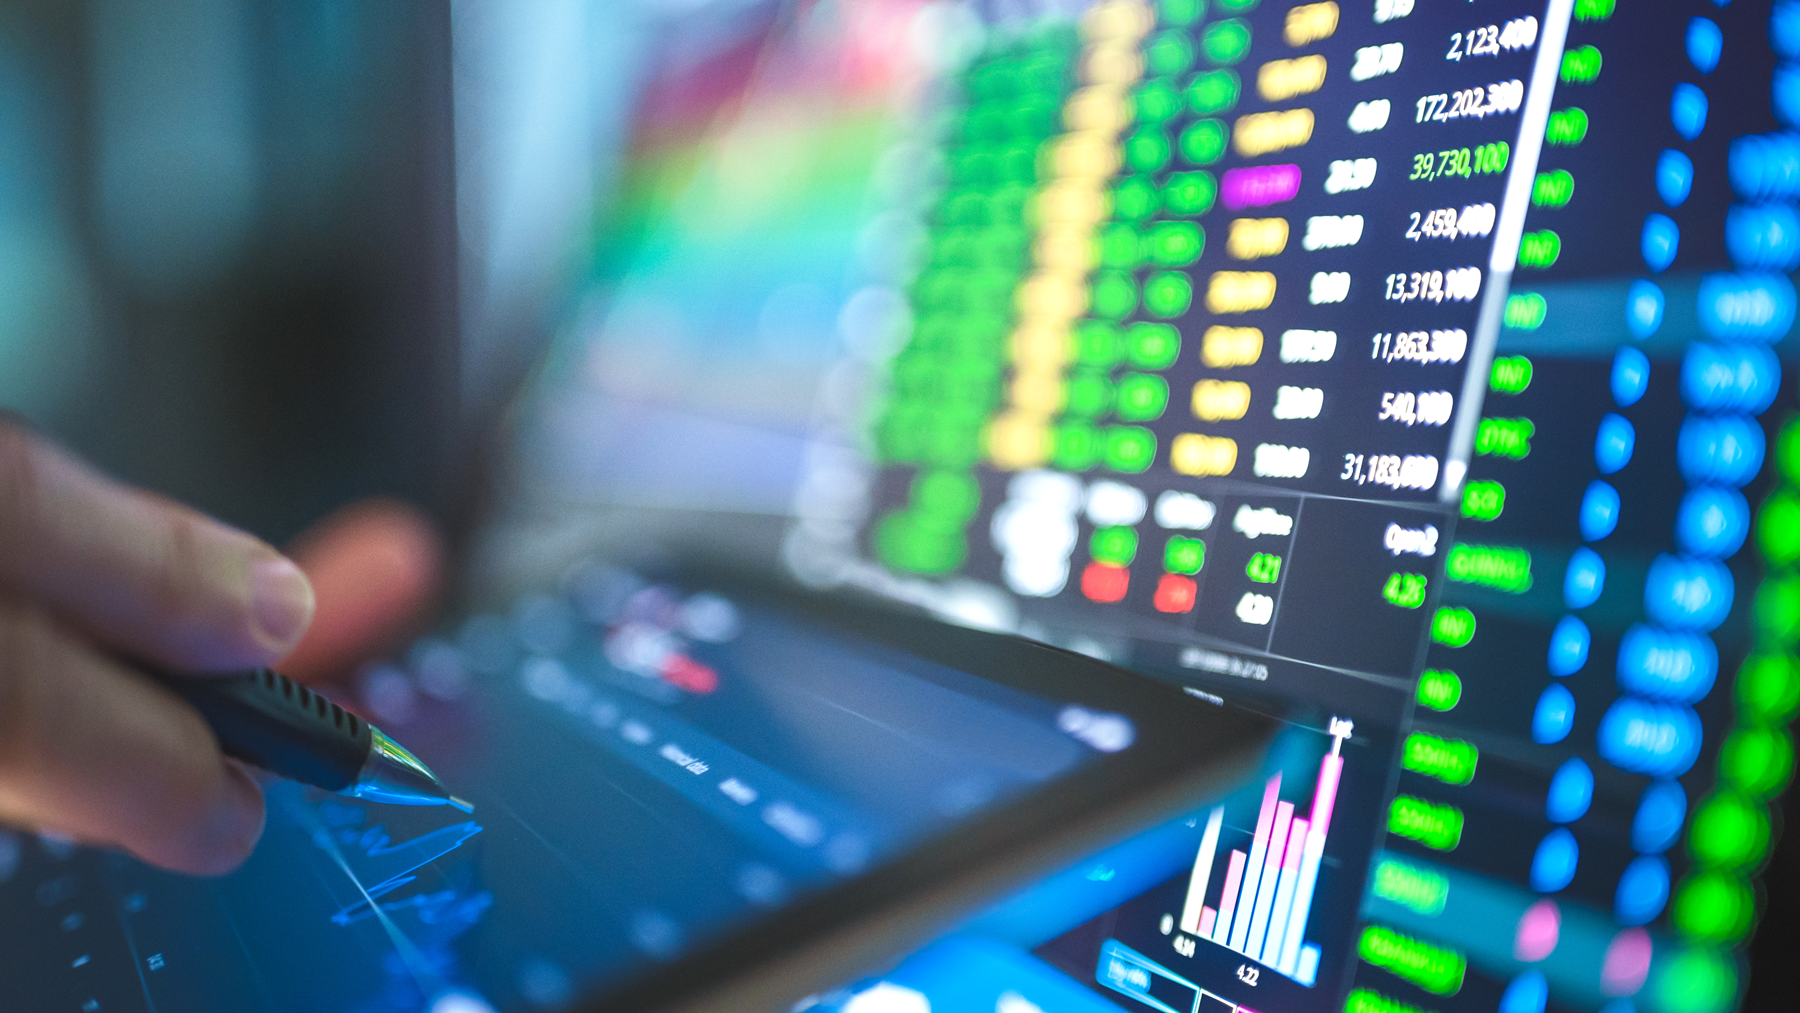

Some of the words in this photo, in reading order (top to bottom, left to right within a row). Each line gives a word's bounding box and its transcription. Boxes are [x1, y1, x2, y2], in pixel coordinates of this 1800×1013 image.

[1446, 16, 1538, 61] 2,123,400
[1416, 80, 1524, 123] 172,202,300
[1410, 142, 1508, 180] 39,730,100
[1386, 267, 1481, 303] 13,319,100
